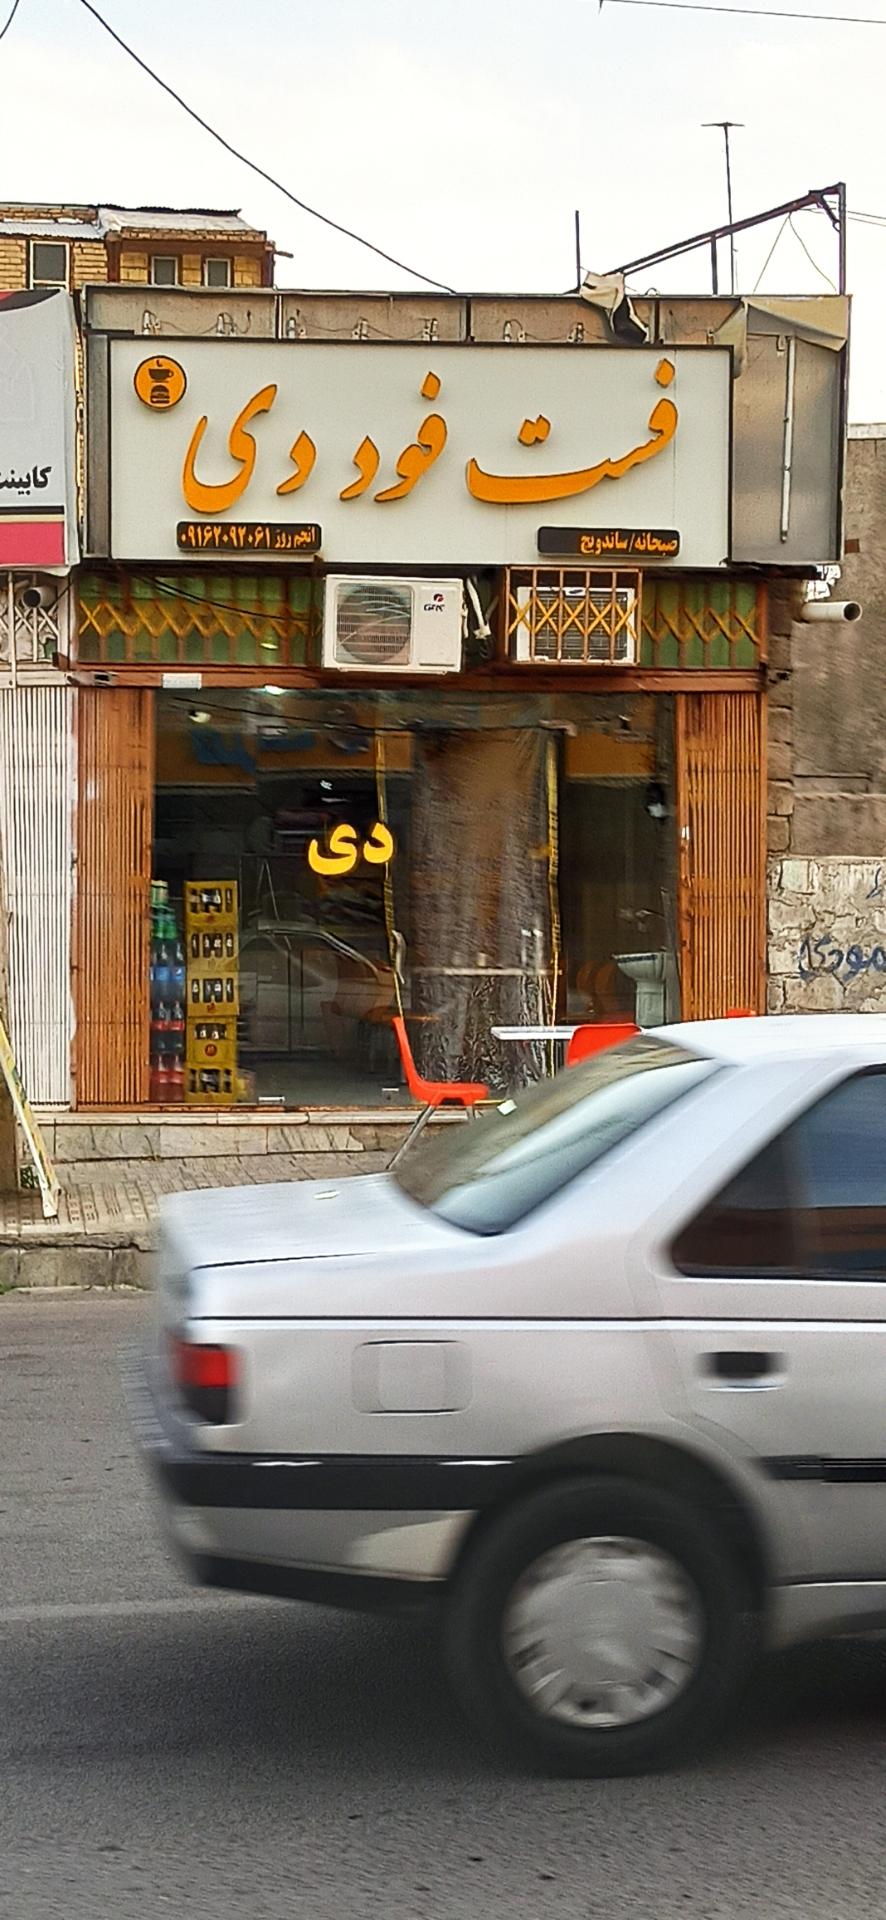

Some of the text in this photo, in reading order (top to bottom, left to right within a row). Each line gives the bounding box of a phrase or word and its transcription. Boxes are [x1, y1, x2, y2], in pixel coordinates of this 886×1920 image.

[182, 357, 678, 514] فست فود دی
[0, 465, 52, 496] کابین
[181, 525, 270, 548] ۰۹۱۶۲۰۹۲۰۶۱
[308, 822, 394, 876] دی
